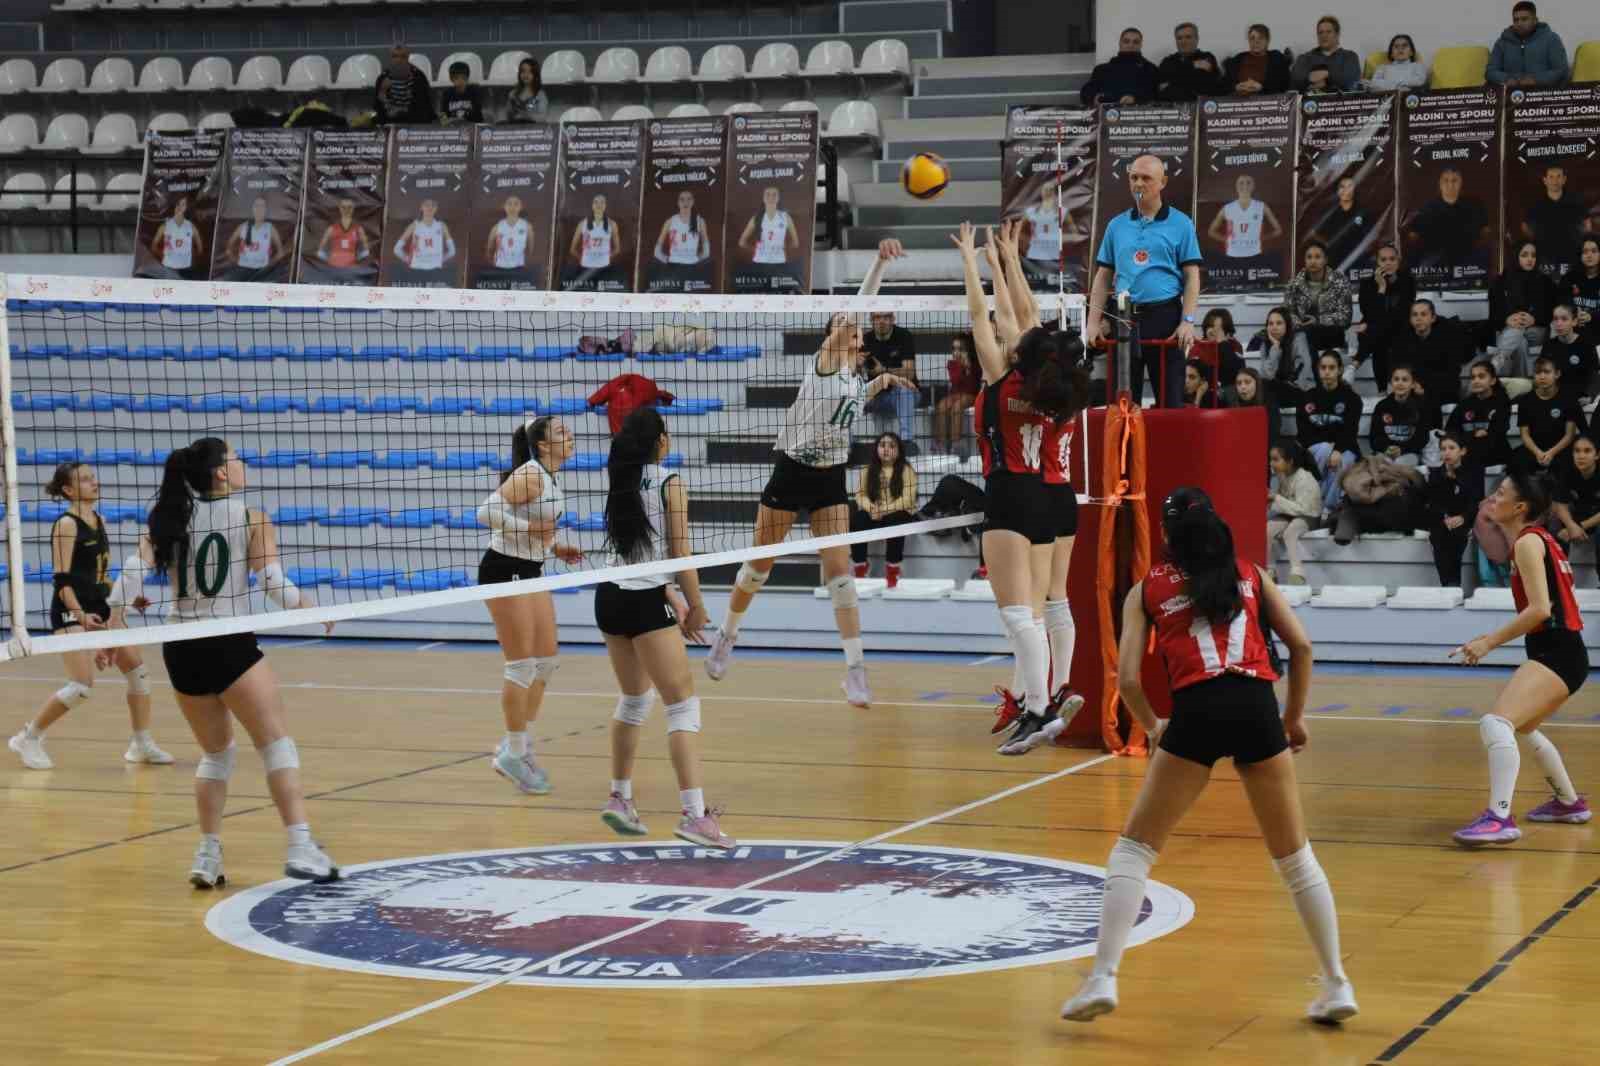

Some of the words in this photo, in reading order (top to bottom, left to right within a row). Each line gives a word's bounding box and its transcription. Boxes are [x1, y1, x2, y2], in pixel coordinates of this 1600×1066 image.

[1409, 112, 1444, 121] KADINI
[1460, 110, 1495, 118] SPORU
[1514, 108, 1550, 117] KADINI
[1208, 118, 1240, 127] KADINI
[1256, 116, 1288, 124] SPORU
[176, 532, 230, 598] 10
[864, 854, 1024, 876] SPOR
